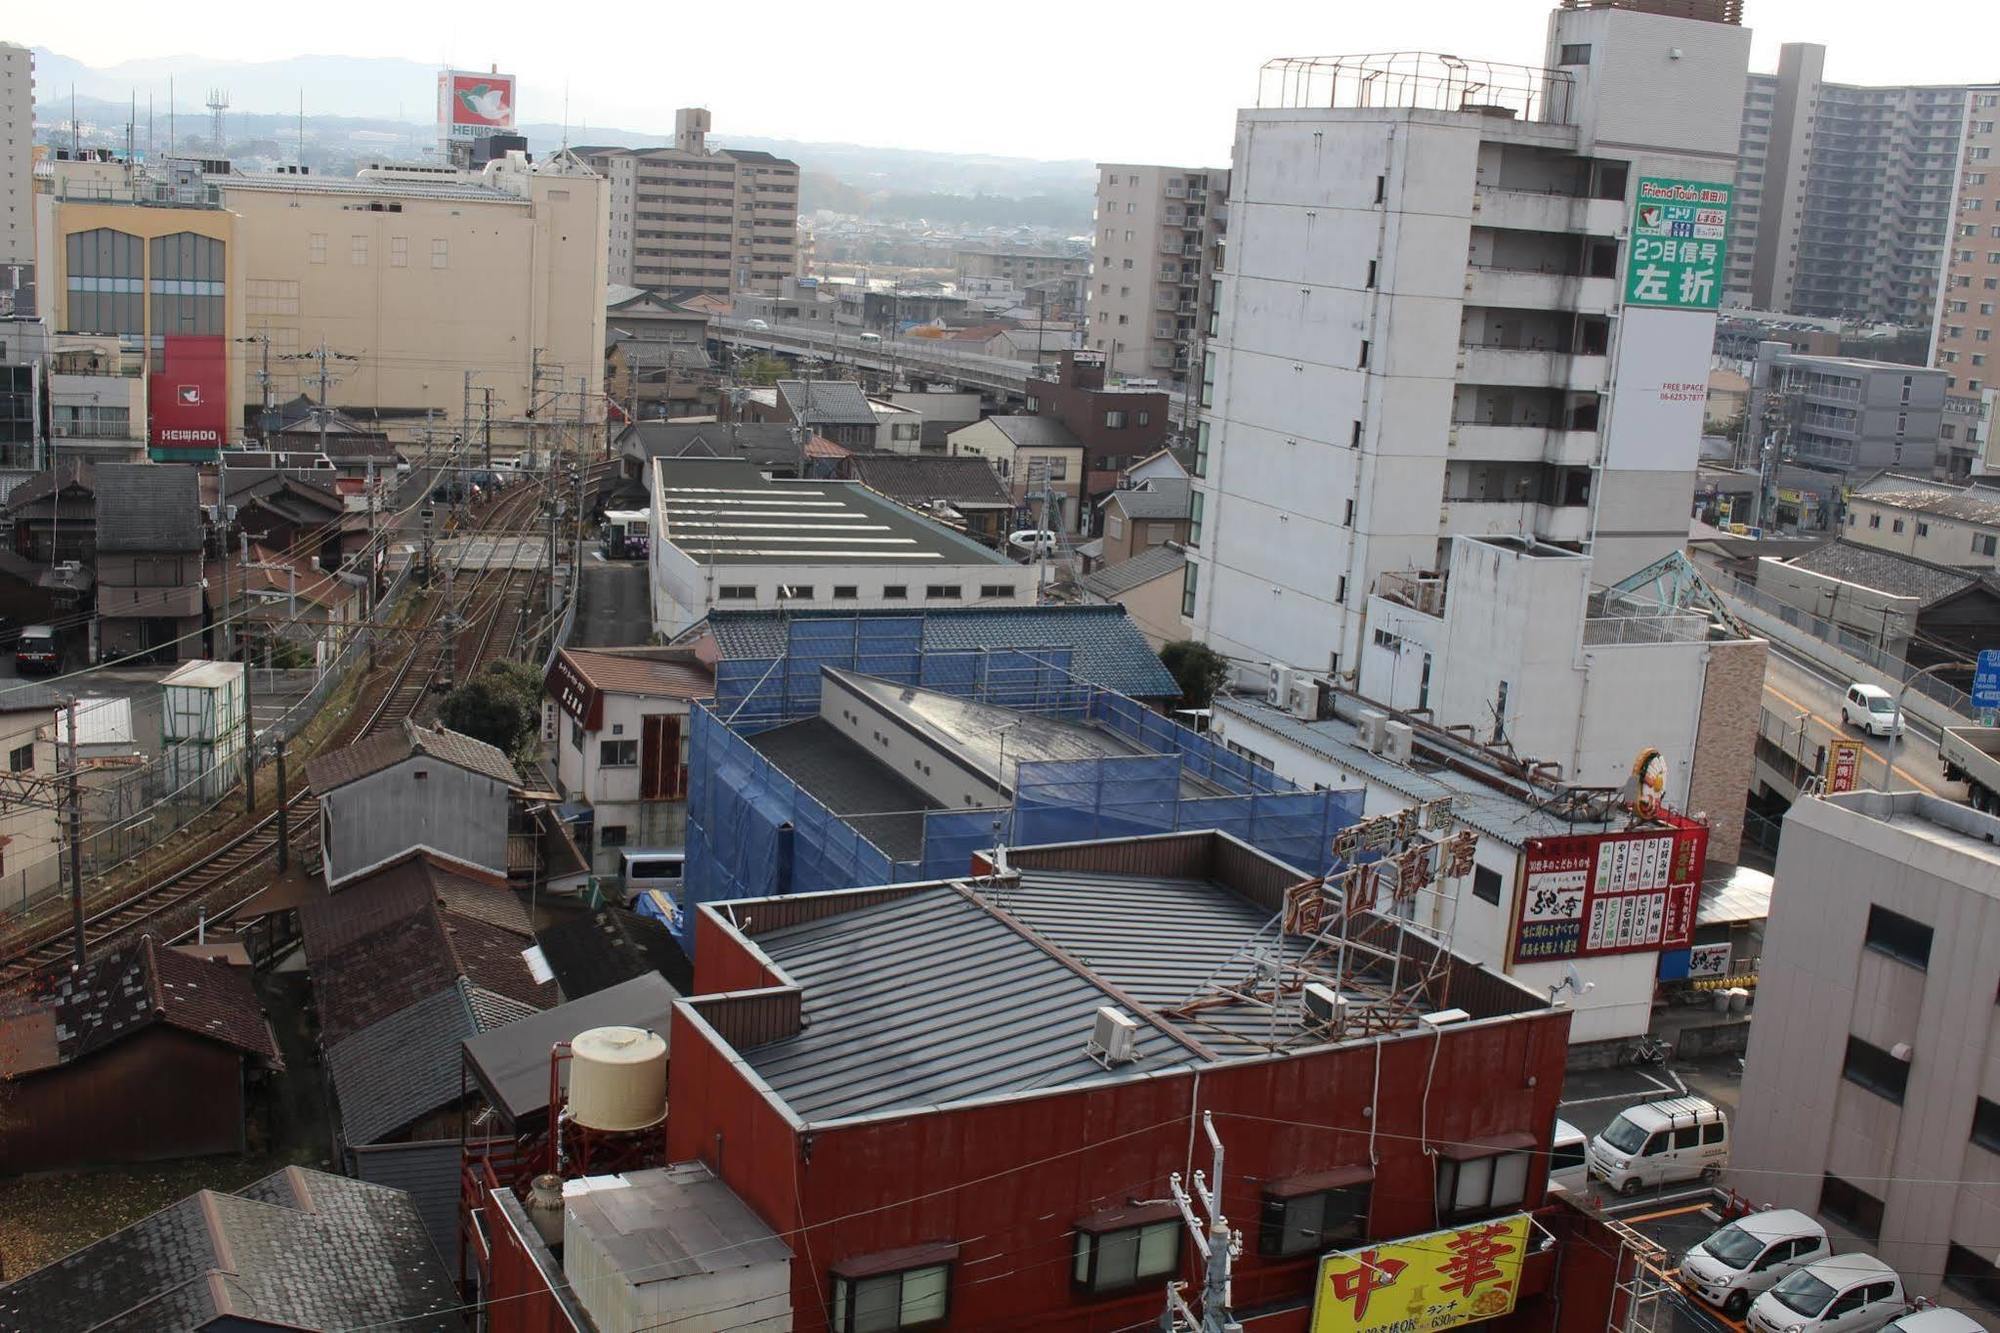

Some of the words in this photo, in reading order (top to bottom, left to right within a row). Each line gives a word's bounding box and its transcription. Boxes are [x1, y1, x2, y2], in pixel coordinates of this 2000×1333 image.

[1667, 207, 1690, 219] ニトリ
[1634, 239, 1718, 265] 2つ目信号
[1634, 264, 1714, 303] 左折
[1682, 383, 1704, 391] SPACE
[161, 429, 217, 441] HEIWADO
[1614, 844, 1626, 883] やきそば
[1628, 842, 1641, 882] たこ焼
[1643, 841, 1655, 878] おでん
[1329, 1223, 1517, 1322] 中華
[1427, 1299, 1458, 1314] ランチ
